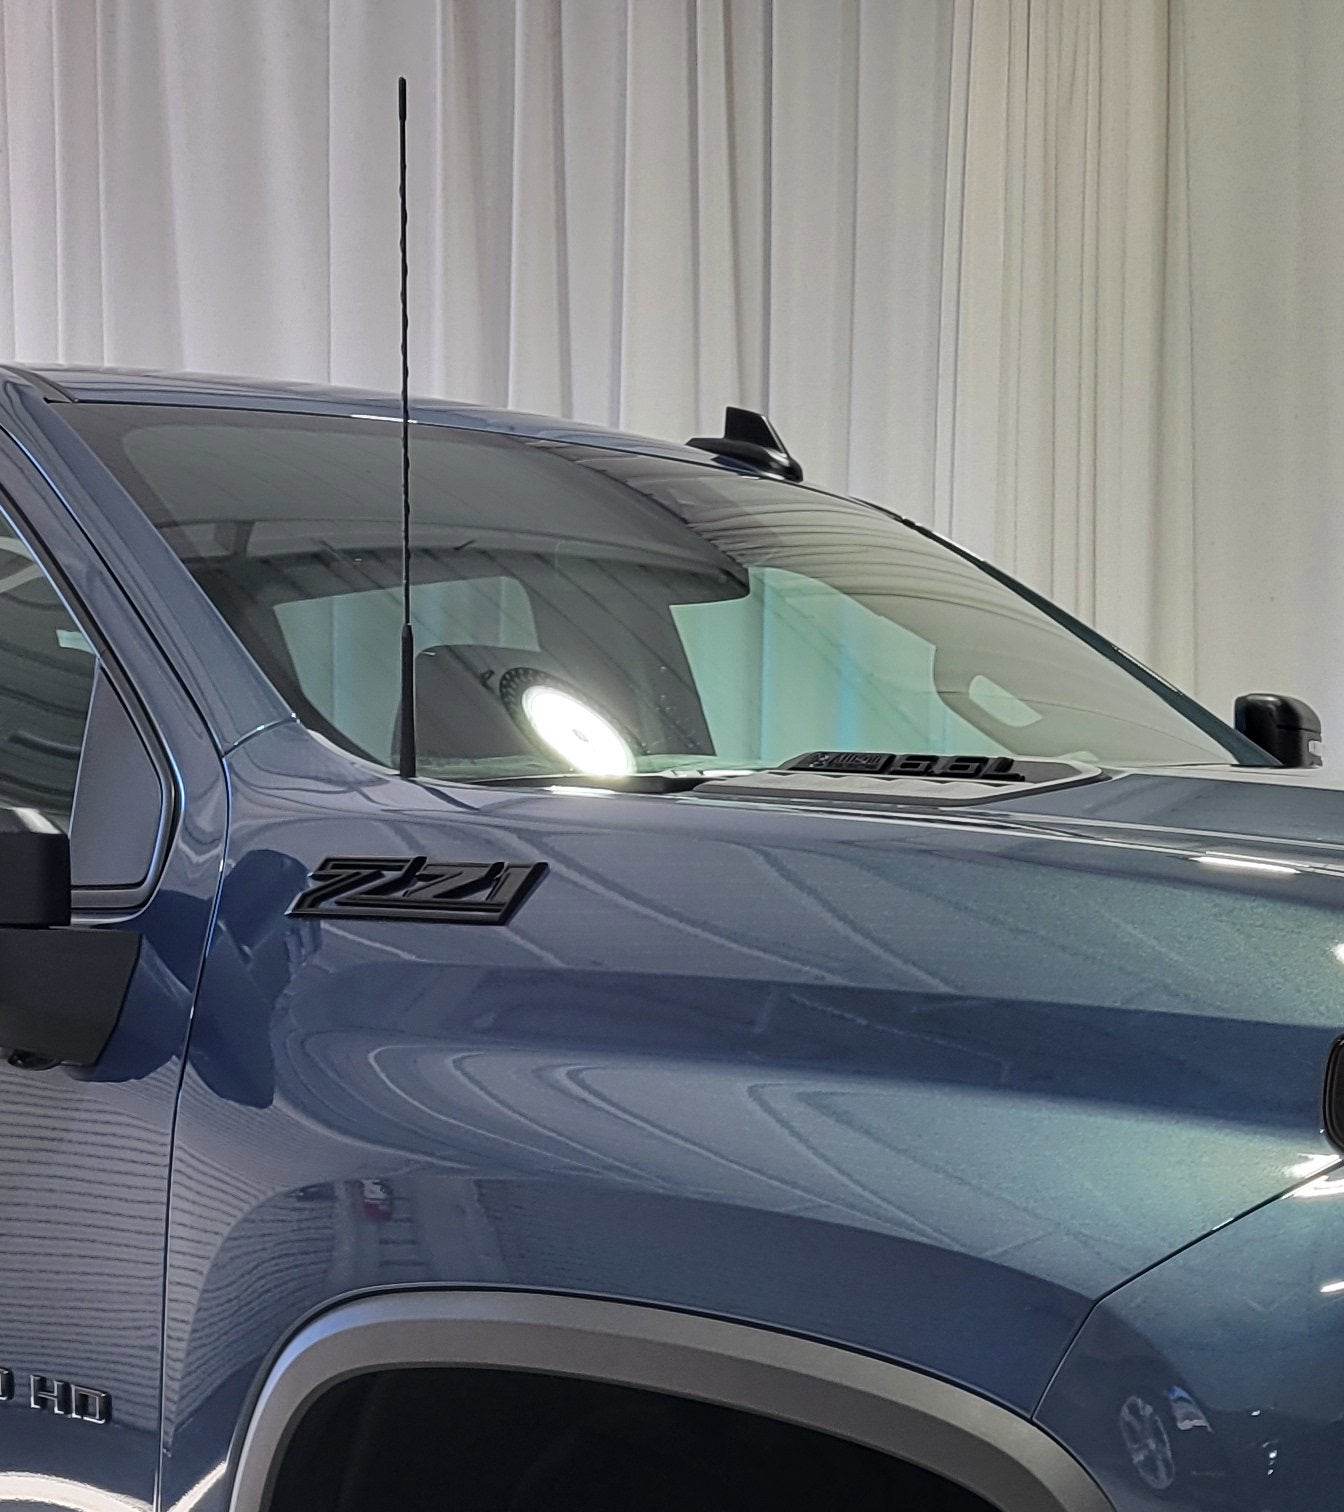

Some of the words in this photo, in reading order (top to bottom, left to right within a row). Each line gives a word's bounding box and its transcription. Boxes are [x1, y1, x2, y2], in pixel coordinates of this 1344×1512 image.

[886, 753, 1025, 783] 6.6L
[284, 856, 552, 926] Z71
[29, 1373, 113, 1424] HD
